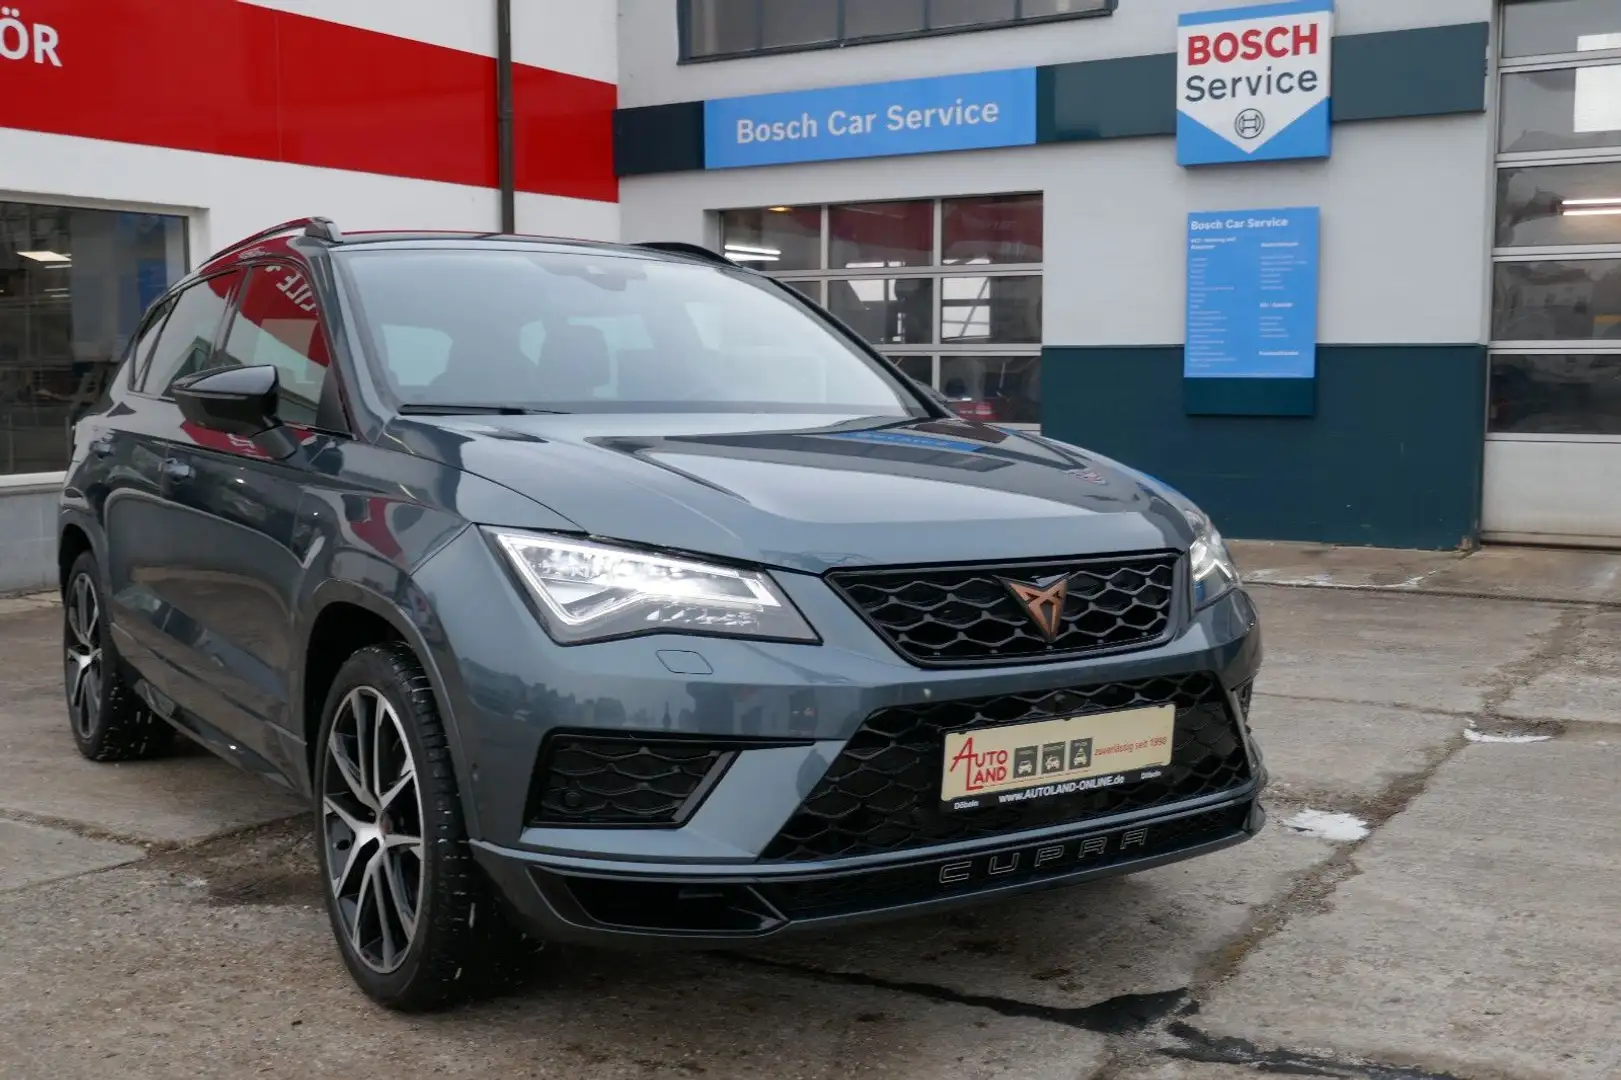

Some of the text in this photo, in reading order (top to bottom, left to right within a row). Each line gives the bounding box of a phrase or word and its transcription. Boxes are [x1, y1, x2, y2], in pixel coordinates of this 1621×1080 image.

[1187, 23, 1318, 66] BOSCH
[1185, 66, 1318, 102] Service
[736, 98, 999, 144] Bosch Car Service
[1190, 216, 1289, 231] Bosch Car Service
[950, 737, 1008, 772] AUTO
[966, 762, 1007, 791] LAND
[998, 774, 1125, 804] www.AUTOLAND-ONLINE.de
[938, 827, 1149, 884] CUPRA
